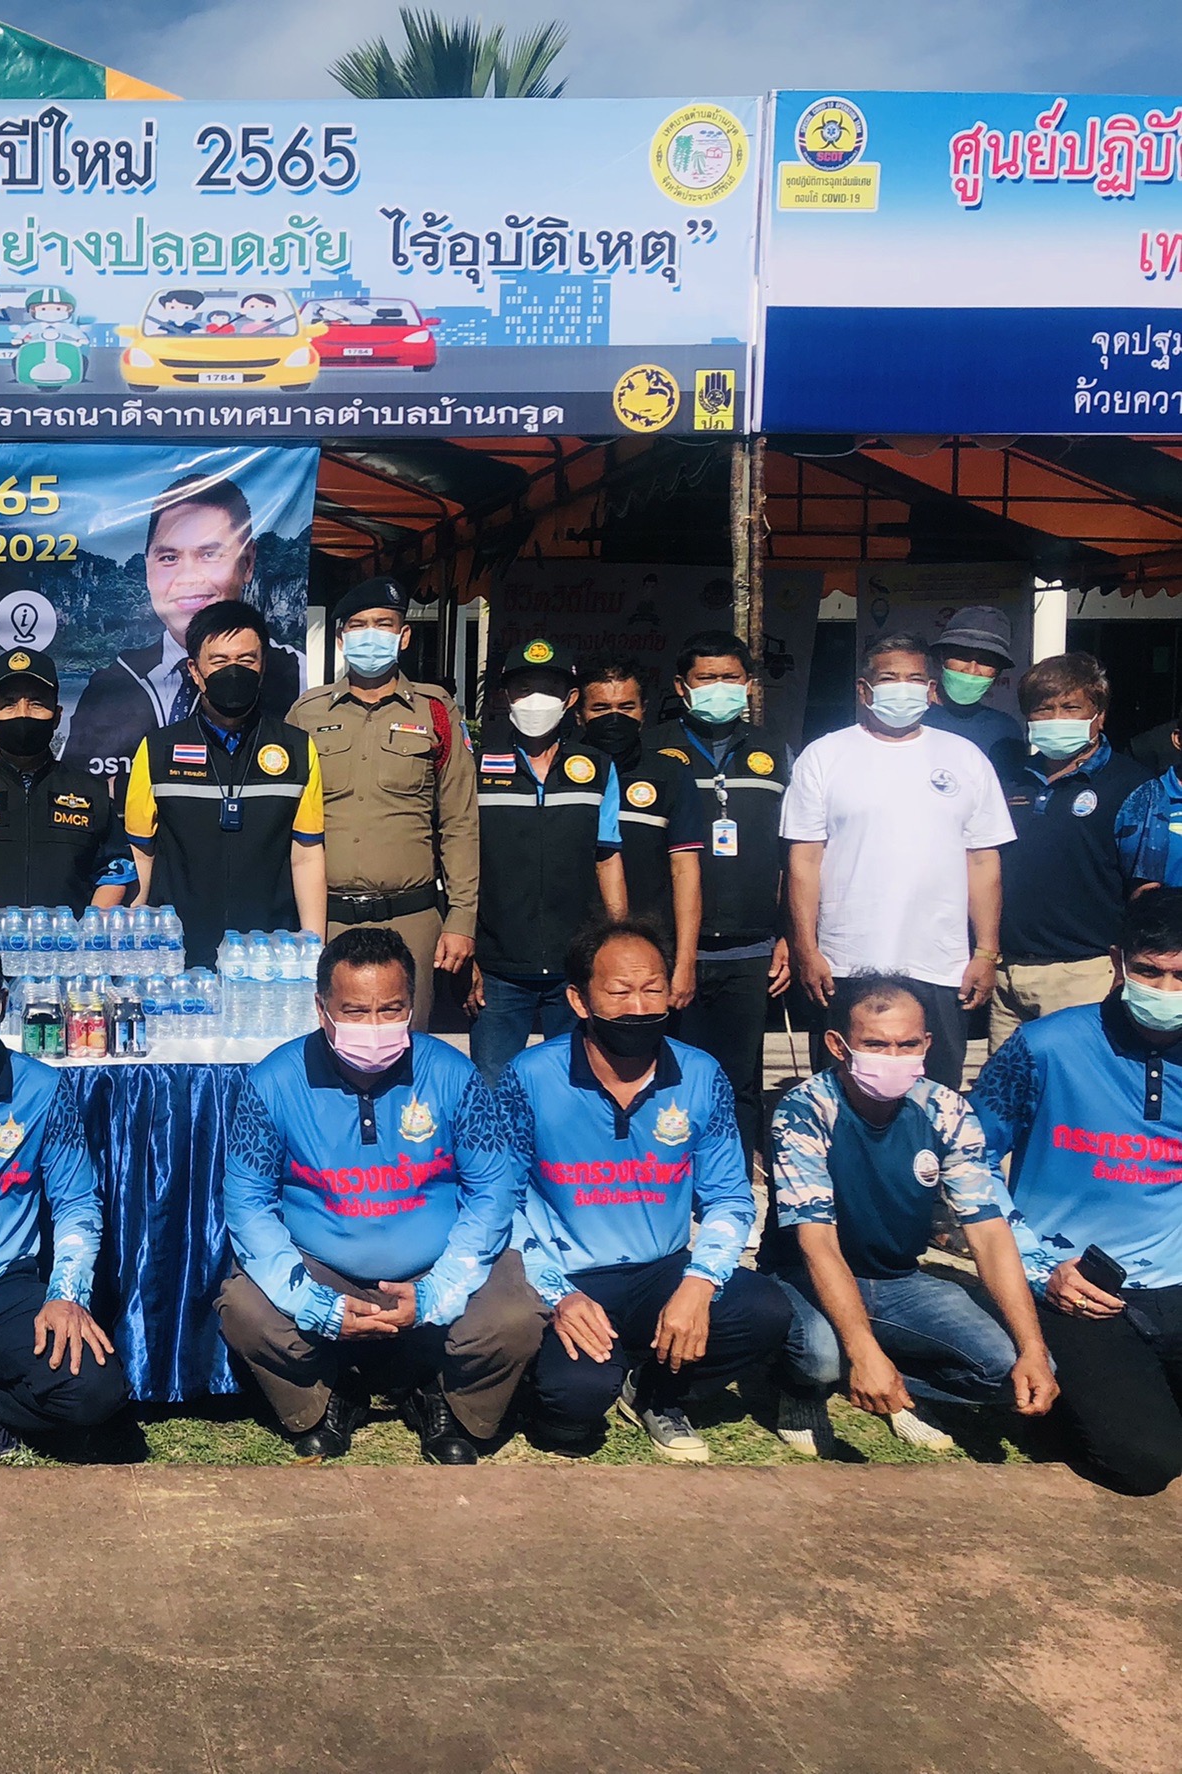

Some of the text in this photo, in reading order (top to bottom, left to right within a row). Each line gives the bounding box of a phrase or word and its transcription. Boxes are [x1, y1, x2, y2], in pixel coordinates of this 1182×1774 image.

[195, 126, 357, 188] 2565
[822, 193, 861, 203] COVID-19
[53, 811, 89, 828] DMCR
